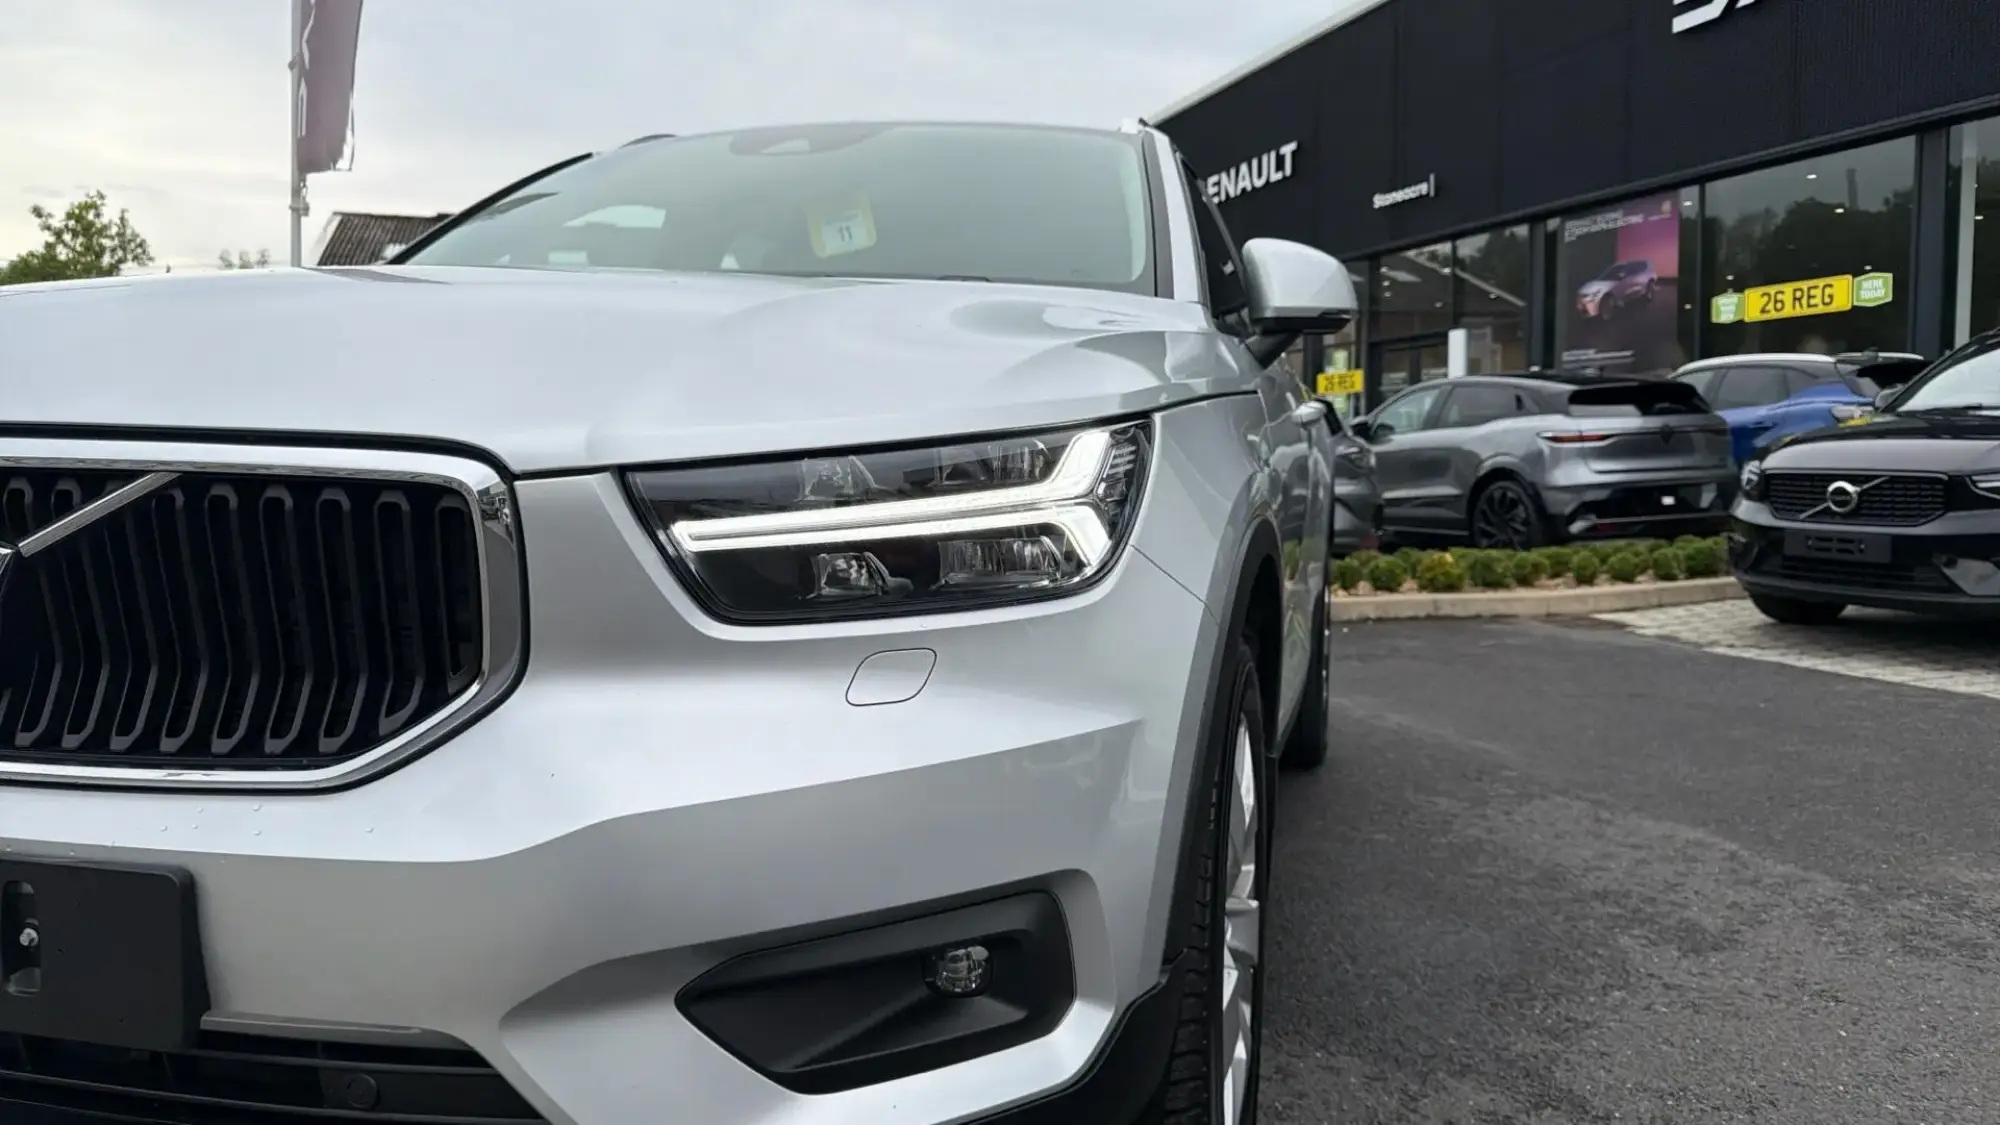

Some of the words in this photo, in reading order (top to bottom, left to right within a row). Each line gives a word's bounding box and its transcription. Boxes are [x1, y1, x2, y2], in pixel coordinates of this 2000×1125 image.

[1201, 140, 1298, 205] ENAULT
[1759, 291, 1786, 315] 26
[1791, 283, 1835, 311] REG
[1859, 288, 1886, 300] TODAY
